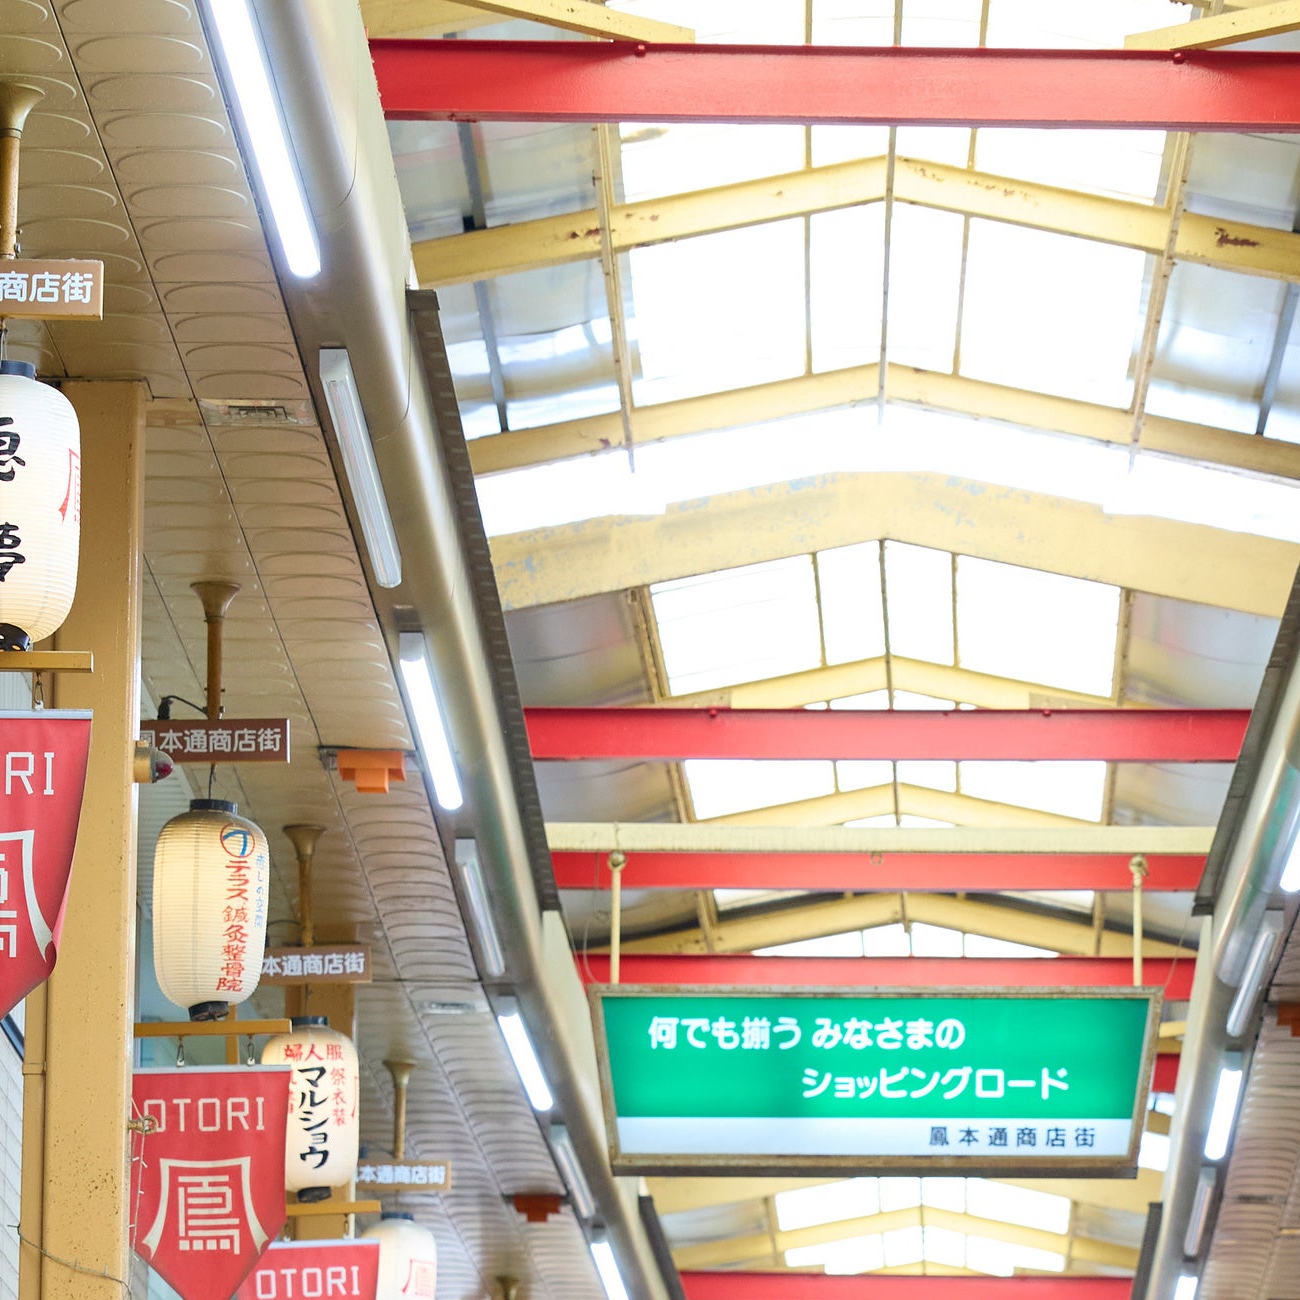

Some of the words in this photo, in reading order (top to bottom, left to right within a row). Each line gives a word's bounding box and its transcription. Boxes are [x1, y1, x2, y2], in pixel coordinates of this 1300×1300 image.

[648, 1016, 801, 1050] 何でも揃う
[811, 1017, 965, 1051] みなさまの
[284, 1044, 344, 1062] 婦人服
[802, 1067, 1069, 1099] ショッピングロード
[144, 1096, 266, 1135] OTORI
[297, 1066, 329, 1169] マルショウ
[928, 1126, 1096, 1149] 鳳本通商店街
[255, 1265, 361, 1300] OTORI
